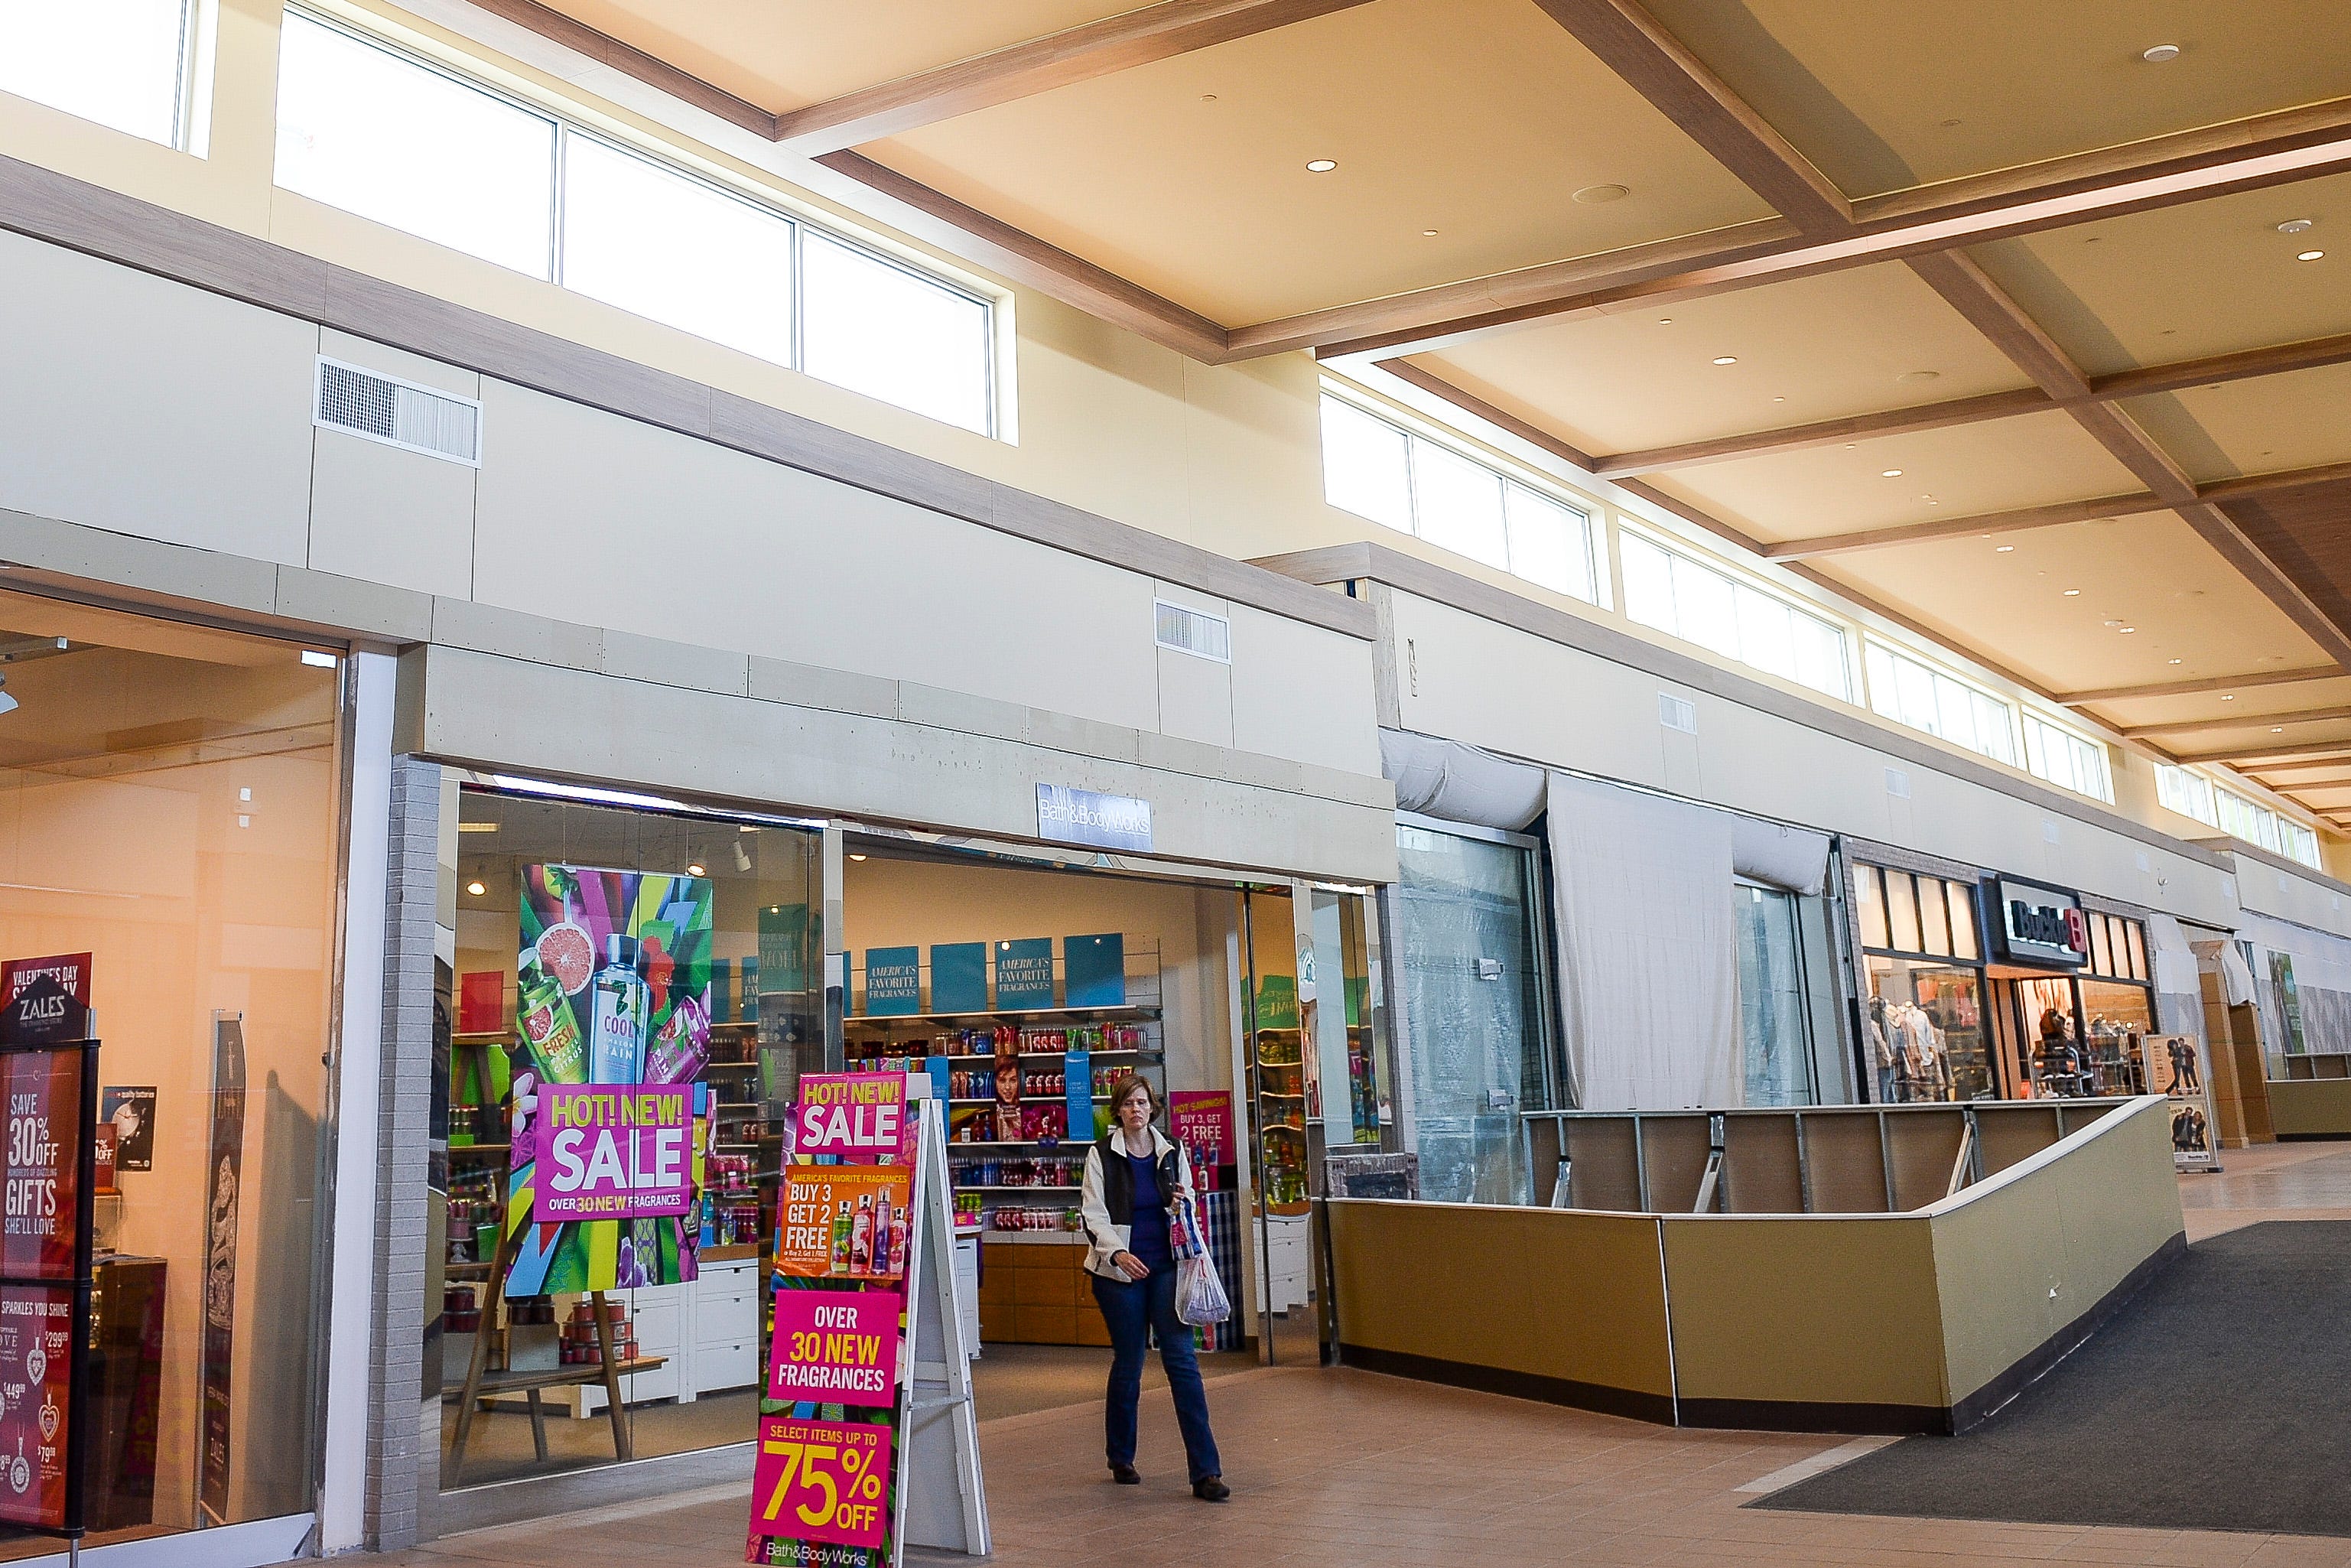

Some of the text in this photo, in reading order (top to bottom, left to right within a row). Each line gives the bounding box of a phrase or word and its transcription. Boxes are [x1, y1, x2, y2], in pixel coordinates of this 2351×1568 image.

[63, 965, 78, 981] DAY
[869, 977, 917, 988] FAVORITE
[999, 969, 1050, 982] FAVORITE
[20, 995, 65, 1020] ZALES
[605, 1015, 636, 1039] COOL
[543, 1022, 576, 1057] FRESH
[11, 1094, 37, 1115] SAVE
[804, 1082, 900, 1105] HOT! NEW!
[551, 1094, 683, 1127] HOT! NEW!
[1180, 1114, 1195, 1124] BUY
[1207, 1114, 1221, 1124] GET
[802, 1105, 899, 1147] SALE
[1181, 1126, 1222, 1140] 2 FREE
[8, 1117, 59, 1166] 30% OFF
[550, 1128, 683, 1192] SALE
[792, 1174, 907, 1183] AMERICA'S FAVORITE FRAGRANCES
[5, 1179, 57, 1216] GIFTS
[549, 1194, 681, 1212] OVER 30 NEW FRAGRANCES
[790, 1184, 831, 1202] BUY 3
[788, 1204, 831, 1224] GET 2
[5, 1218, 56, 1235] SHE'LL LOVE
[785, 1226, 828, 1249] FREE
[2, 1301, 69, 1317] SPARKLES YOU SHINE
[815, 1306, 857, 1329] OVER
[789, 1331, 881, 1366] 30 NEW
[778, 1364, 885, 1392] FRAGRANCES
[770, 1425, 878, 1446] SELECT ITEMS UP TO
[763, 1440, 882, 1531] 75% OFF
